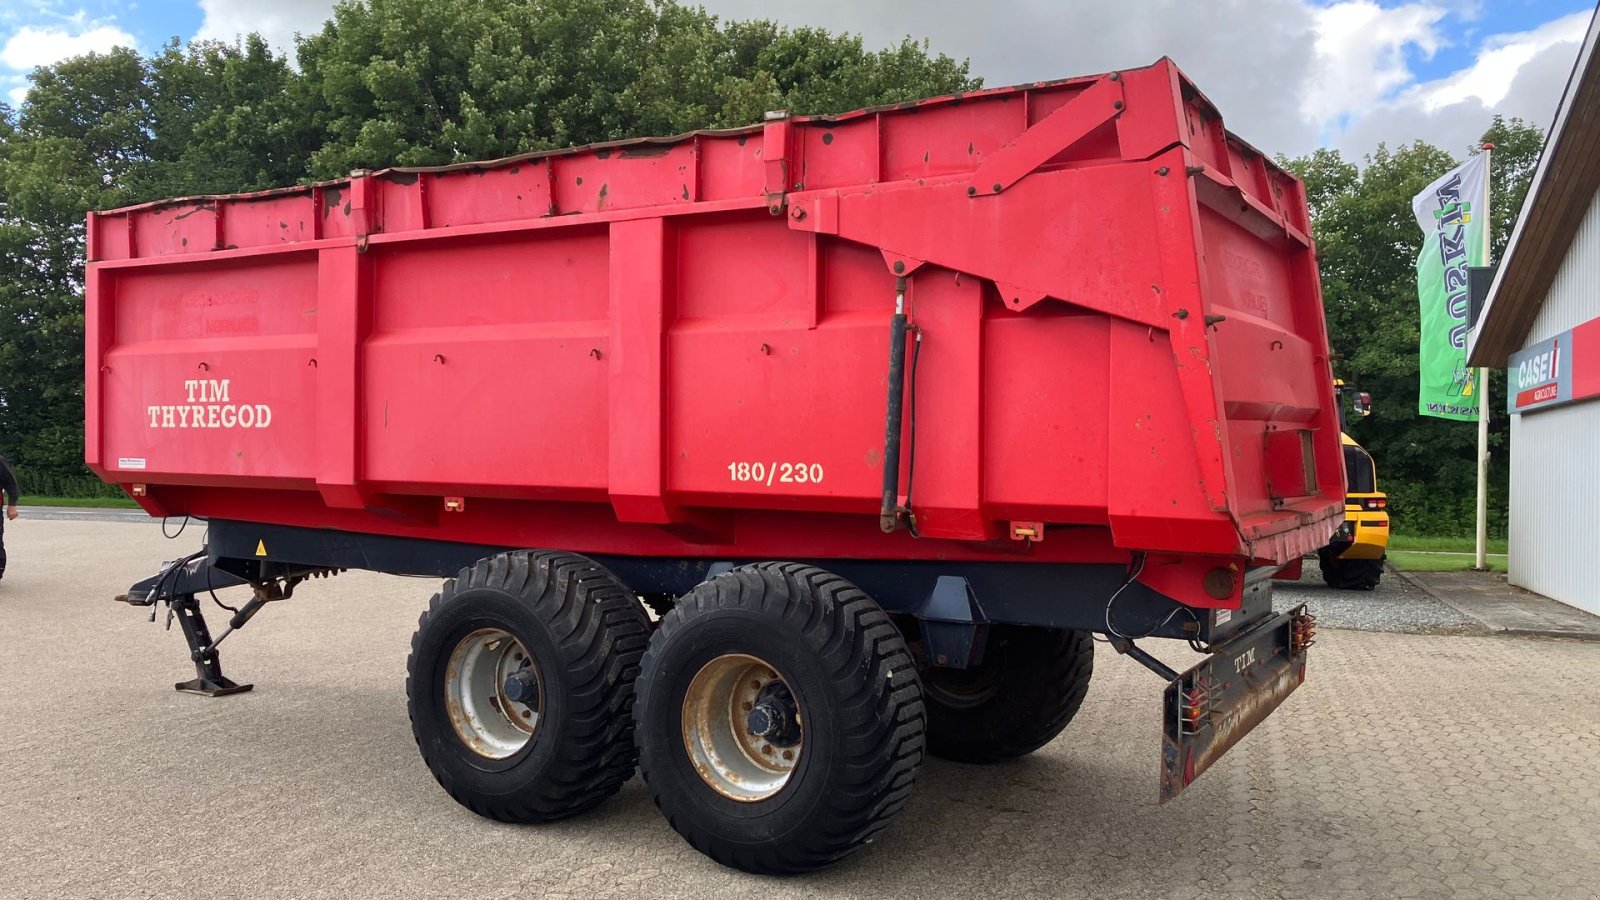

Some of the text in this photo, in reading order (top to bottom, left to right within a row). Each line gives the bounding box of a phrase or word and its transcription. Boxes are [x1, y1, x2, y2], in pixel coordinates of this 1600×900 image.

[1518, 352, 1549, 389] CASE
[184, 378, 230, 403] TIM
[147, 404, 272, 428] THYREGOD
[727, 461, 824, 487] 180/230
[1234, 647, 1256, 674] TIM
